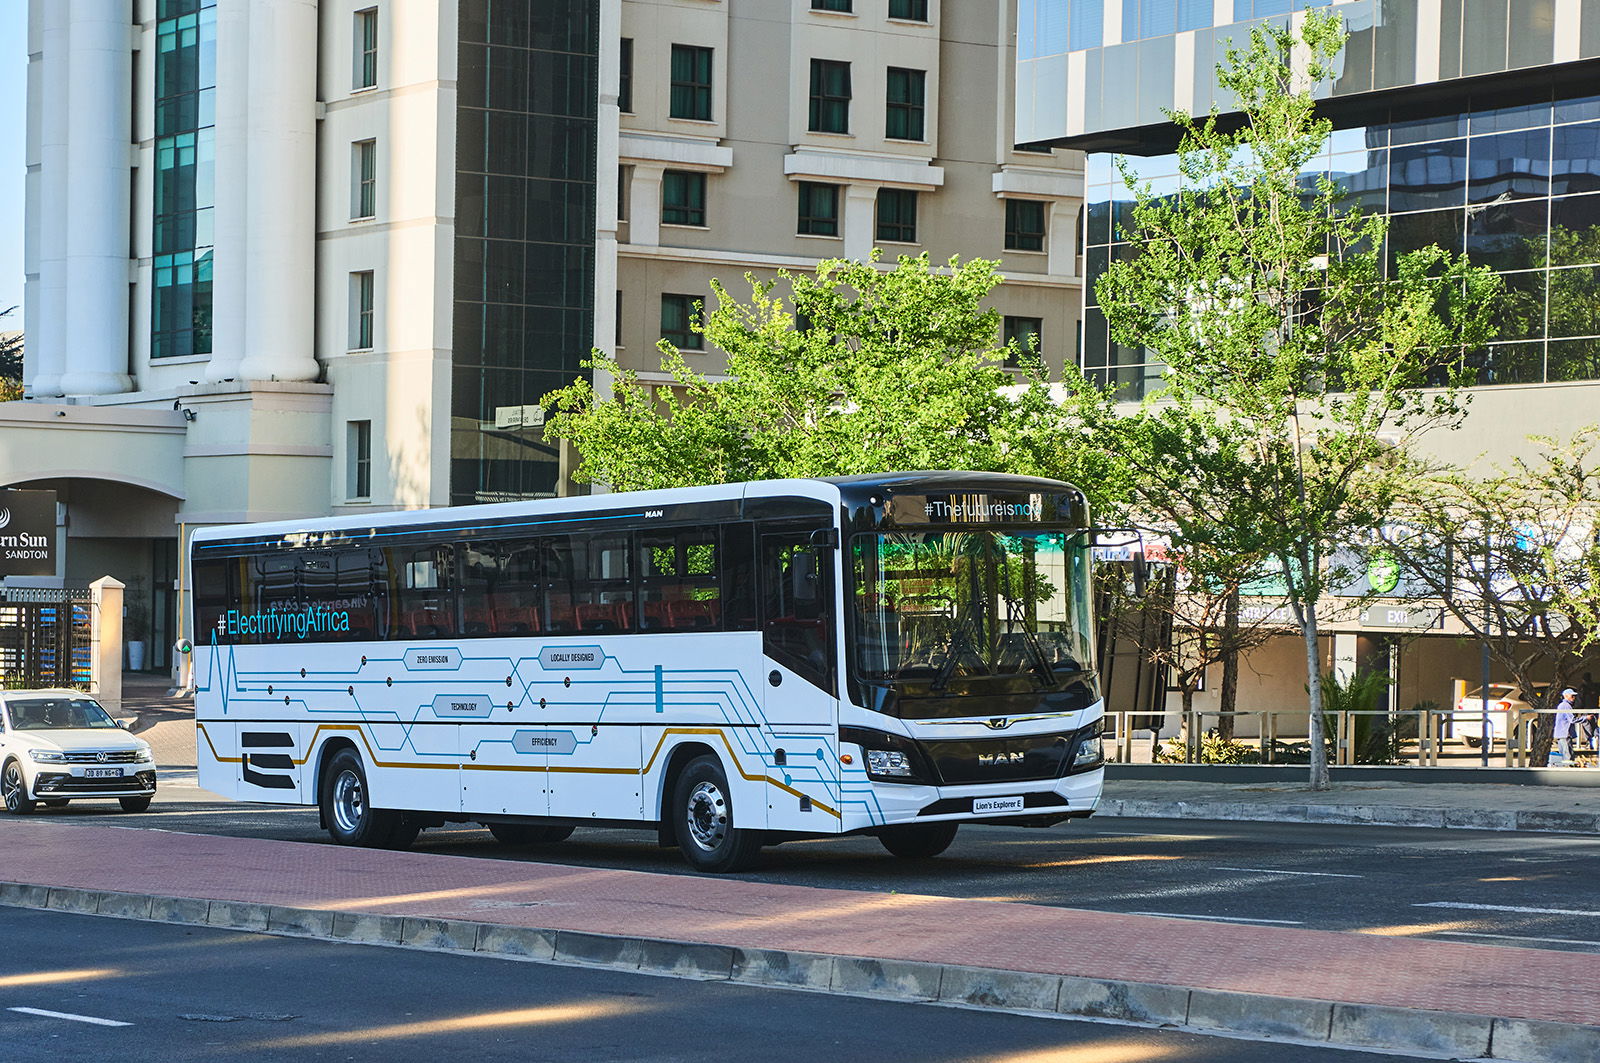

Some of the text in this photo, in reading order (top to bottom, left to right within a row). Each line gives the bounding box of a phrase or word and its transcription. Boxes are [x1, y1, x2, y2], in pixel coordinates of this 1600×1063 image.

[645, 510, 663, 519] MAN
[0, 532, 48, 547] rn Sun
[5, 550, 48, 559] SANDTON
[217, 605, 350, 639] #ElectrifyingAfrica
[416, 655, 449, 664] ZERO EMISSION
[550, 653, 595, 662] LOCALLY DESIGNED
[451, 702, 477, 711] TECHNOLOGY
[531, 737, 557, 746] EFFICIENCY
[978, 751, 1025, 766] MAN
[975, 799, 1021, 810] Lion's Explorer E
